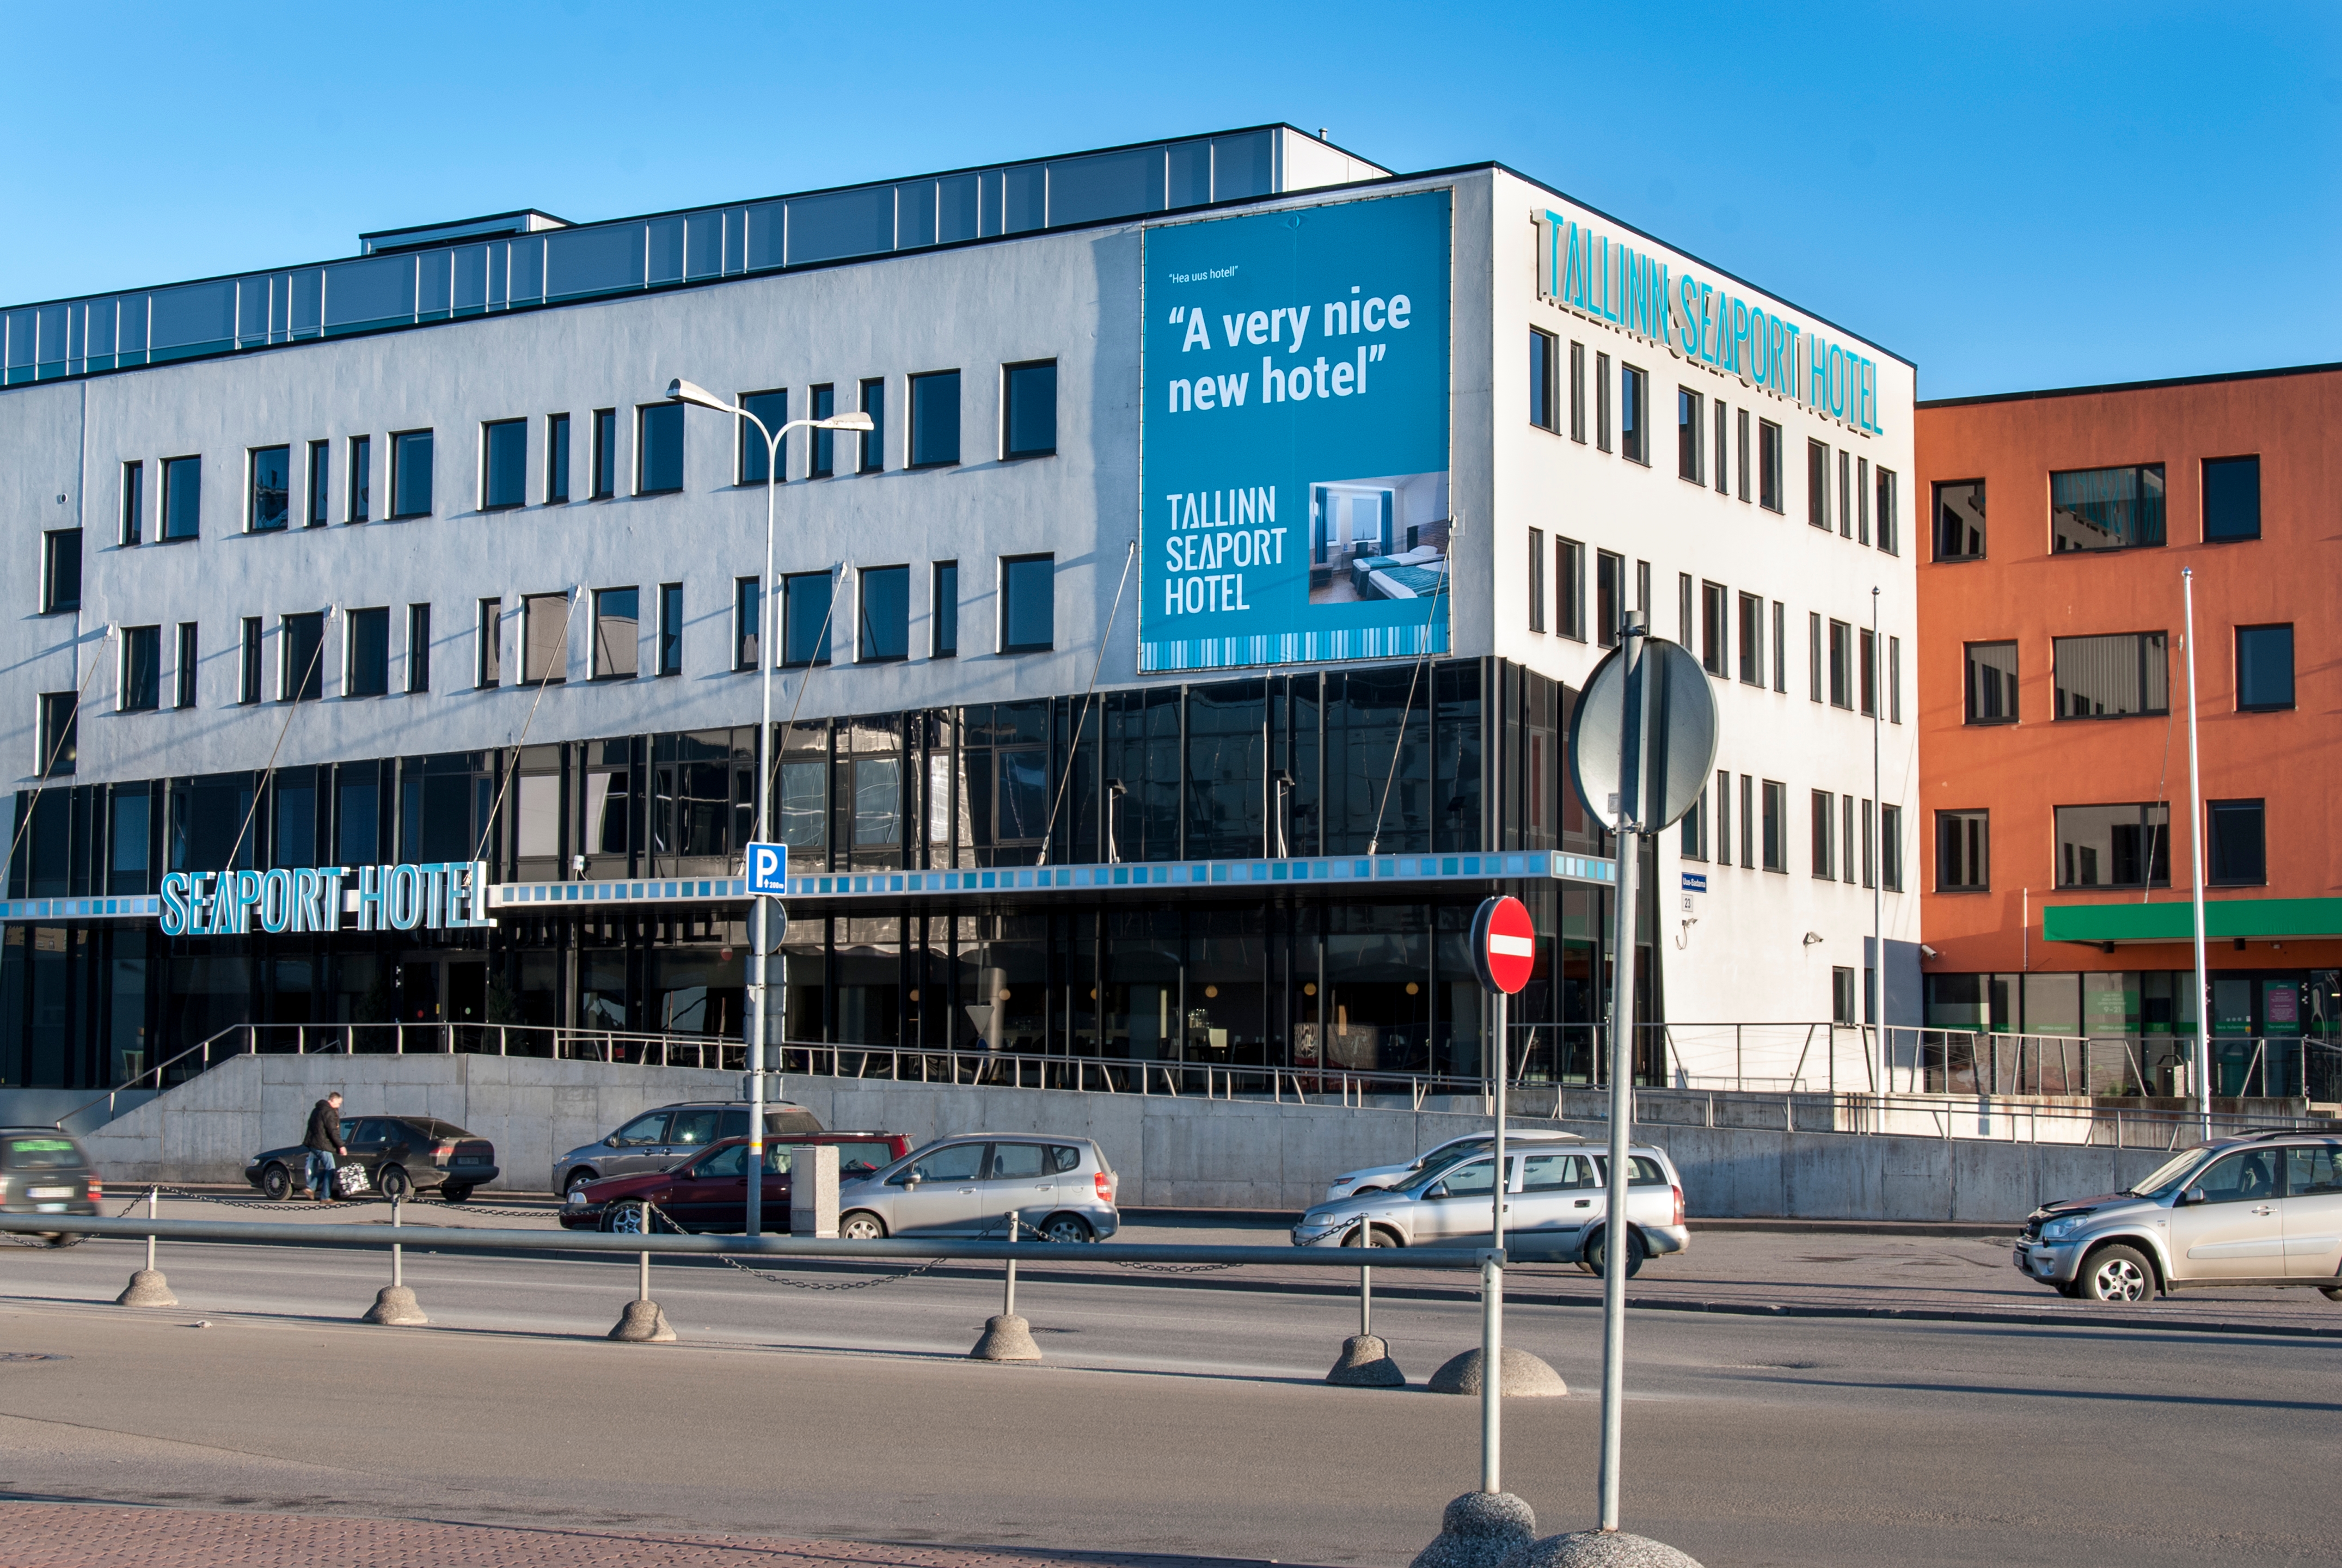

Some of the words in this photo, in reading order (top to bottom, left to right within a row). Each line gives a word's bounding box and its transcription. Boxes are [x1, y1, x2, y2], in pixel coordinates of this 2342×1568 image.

[1192, 272, 1207, 281] uus
[1222, 304, 1311, 353] very
[1324, 285, 1412, 336] nice
[1534, 209, 1669, 346] TALLINN
[1669, 273, 1800, 399] SEAPORT
[1800, 332, 1883, 437] HOTEL
[1169, 371, 1249, 413] new
[1166, 485, 1276, 530] TALLINN
[1165, 526, 1288, 572] SEAPORT
[1164, 574, 1250, 616] HOTEL
[756, 849, 777, 888] P
[160, 867, 350, 936] SEAPORT
[358, 861, 498, 931] HOTEL
[1684, 898, 1691, 908] 23
